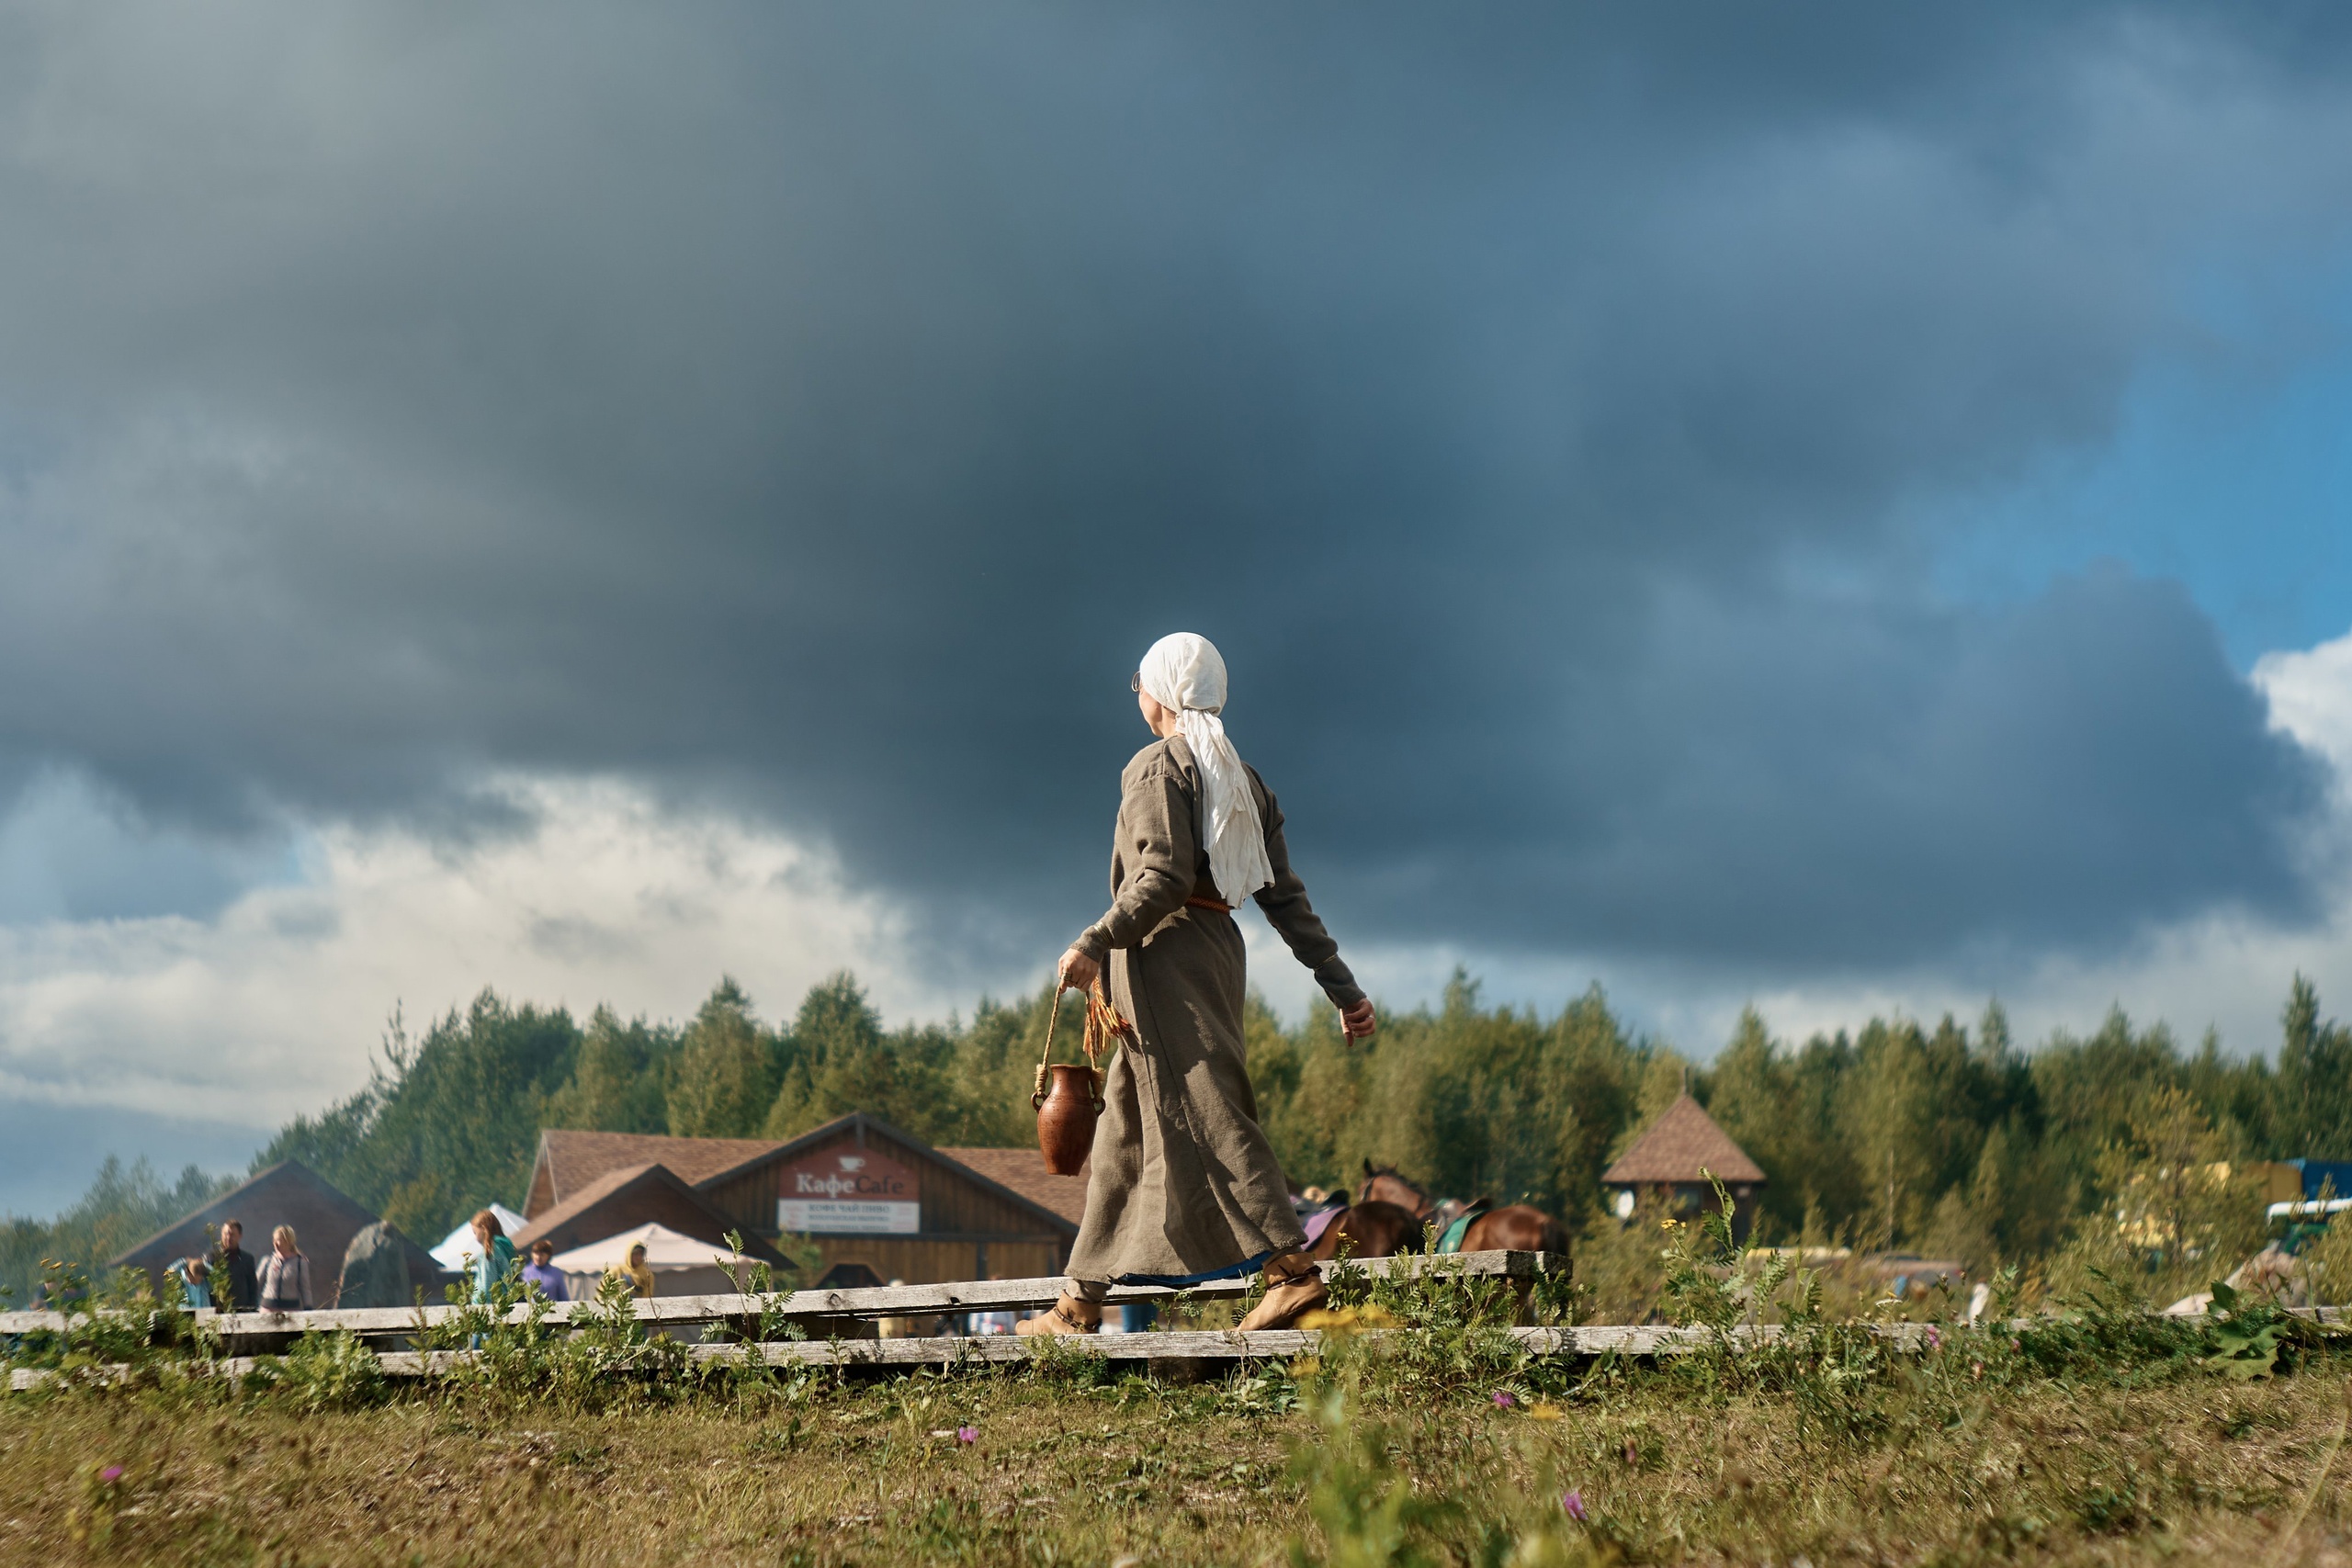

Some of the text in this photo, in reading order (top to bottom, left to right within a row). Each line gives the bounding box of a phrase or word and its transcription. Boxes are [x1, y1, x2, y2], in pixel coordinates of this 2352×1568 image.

[808, 1204, 890, 1213] КОФЕ ЧАЙ ПИВО
